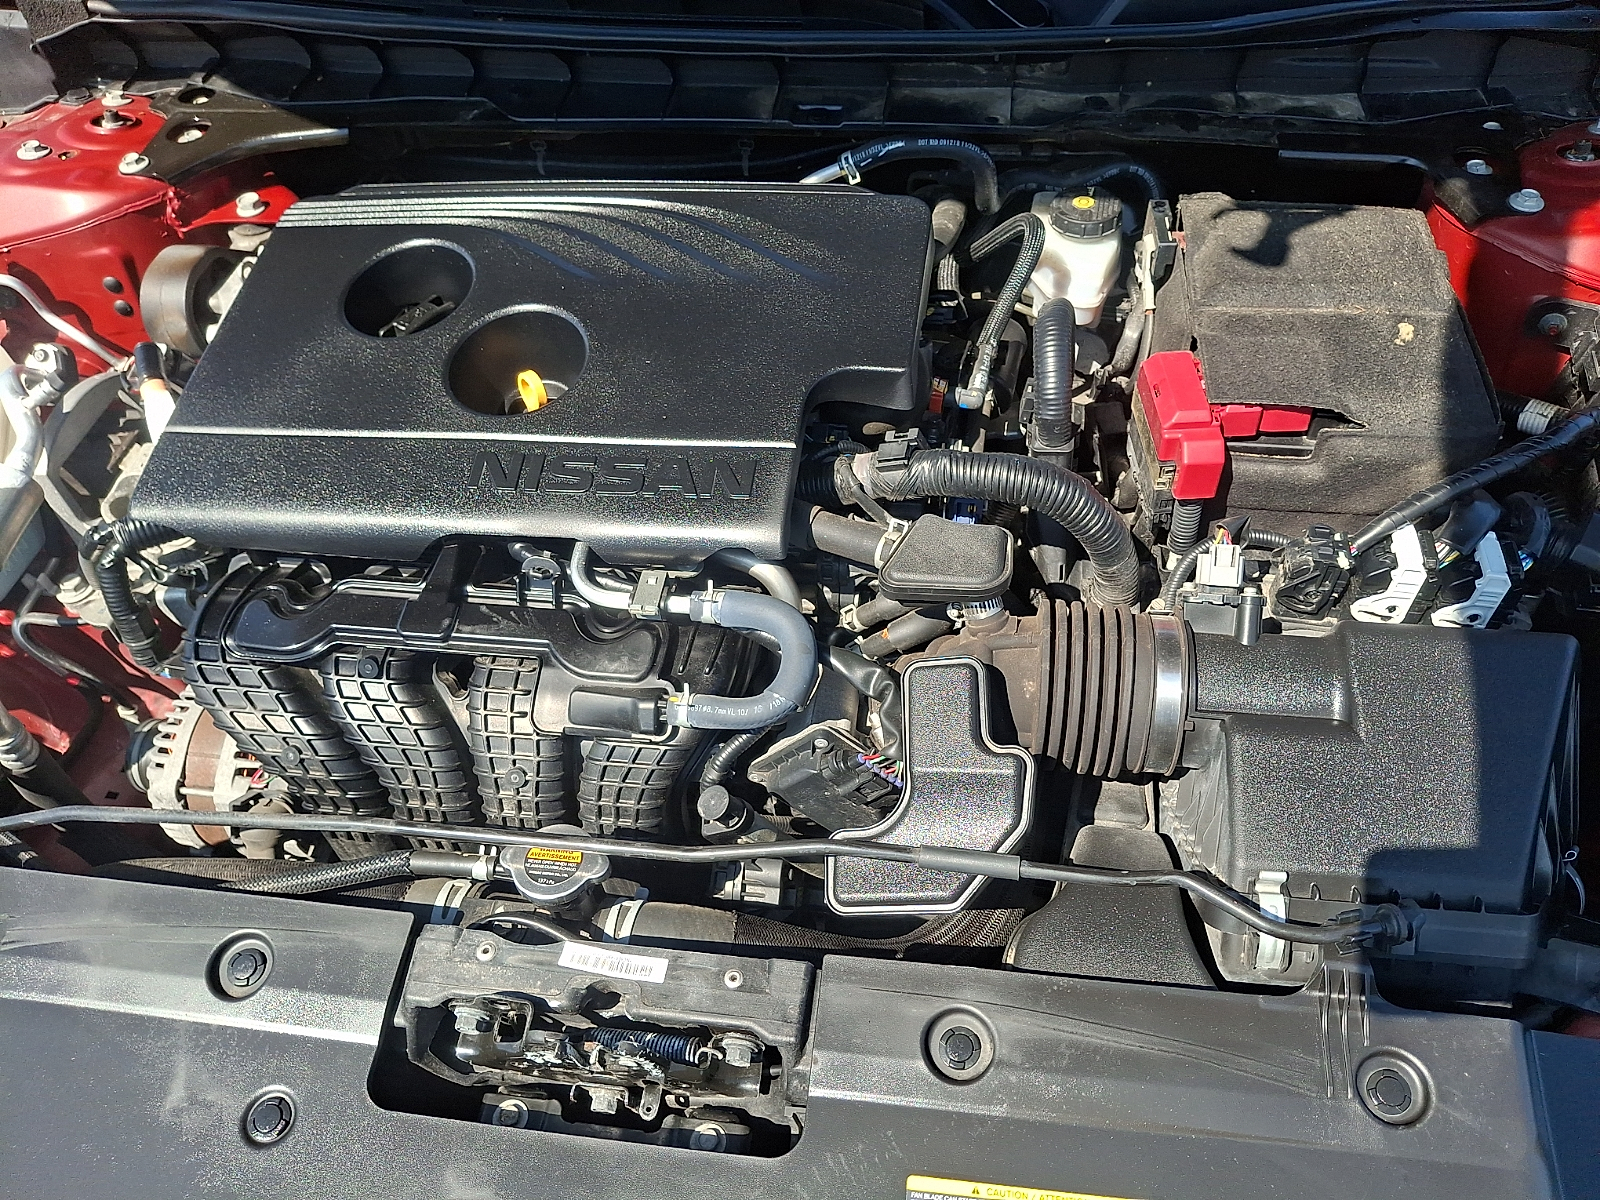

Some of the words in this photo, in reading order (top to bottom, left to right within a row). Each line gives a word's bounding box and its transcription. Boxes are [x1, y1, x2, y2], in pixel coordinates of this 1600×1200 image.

[467, 451, 758, 500] NISSAN
[529, 852, 580, 860] AVERTISSEMENT
[986, 1187, 1028, 1200] CAUTION
